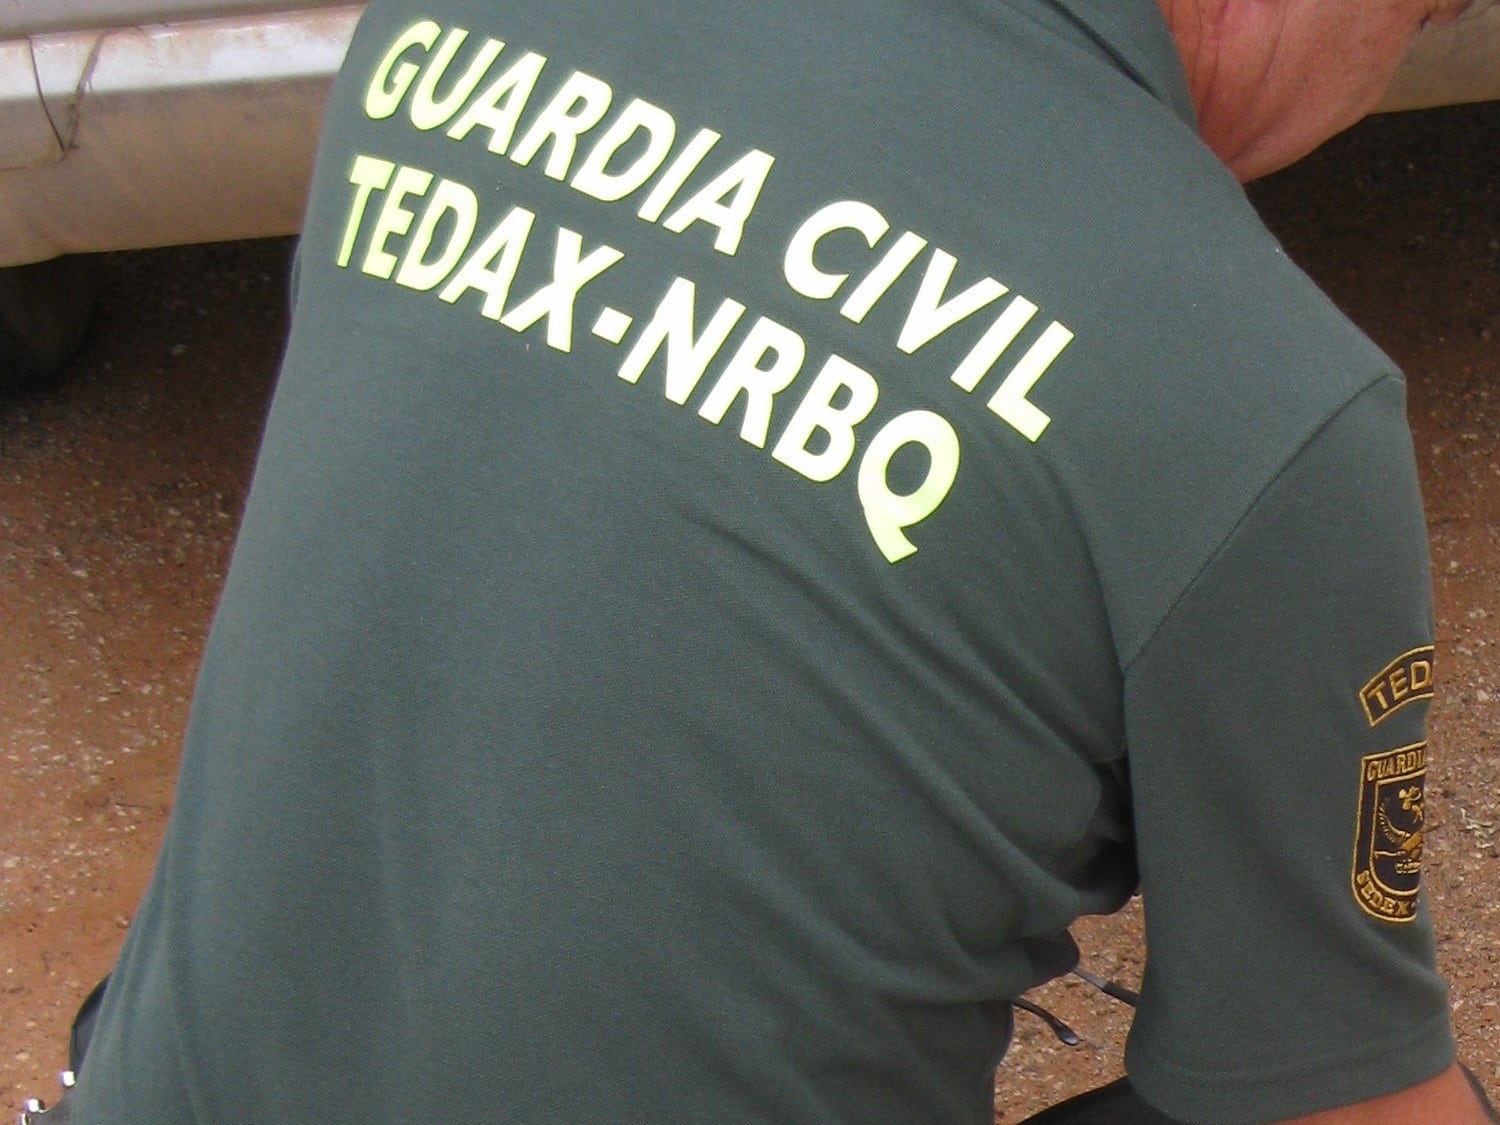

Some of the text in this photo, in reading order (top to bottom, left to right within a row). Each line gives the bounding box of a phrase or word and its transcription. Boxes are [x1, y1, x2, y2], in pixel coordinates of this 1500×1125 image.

[337, 154, 960, 564] TEDAX-NRBQ
[365, 20, 1074, 443] GUARDIA CIVIL
[1367, 660, 1433, 710] TED
